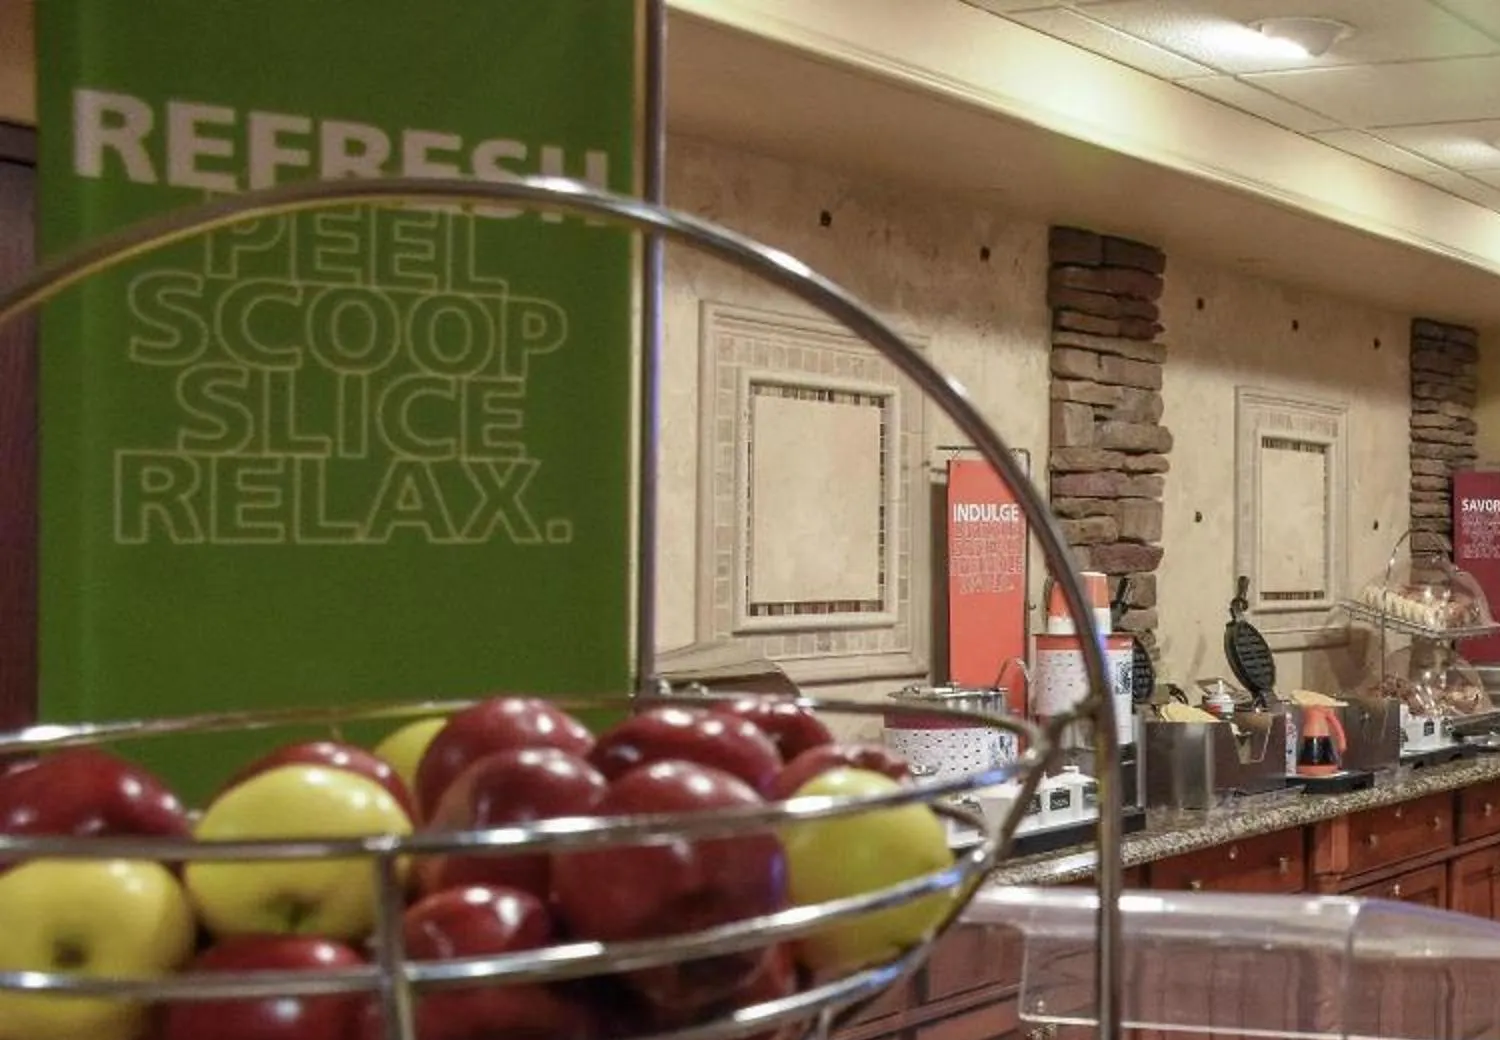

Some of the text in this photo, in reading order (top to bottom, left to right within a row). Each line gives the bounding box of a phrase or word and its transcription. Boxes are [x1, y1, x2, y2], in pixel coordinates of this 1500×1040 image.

[72, 88, 609, 227] REFRESH
[203, 190, 509, 296] PEEL
[127, 269, 568, 382] SCOOP
[174, 361, 528, 463] SLICE
[113, 449, 574, 544] RELAX.
[953, 503, 1020, 522] INDULGE
